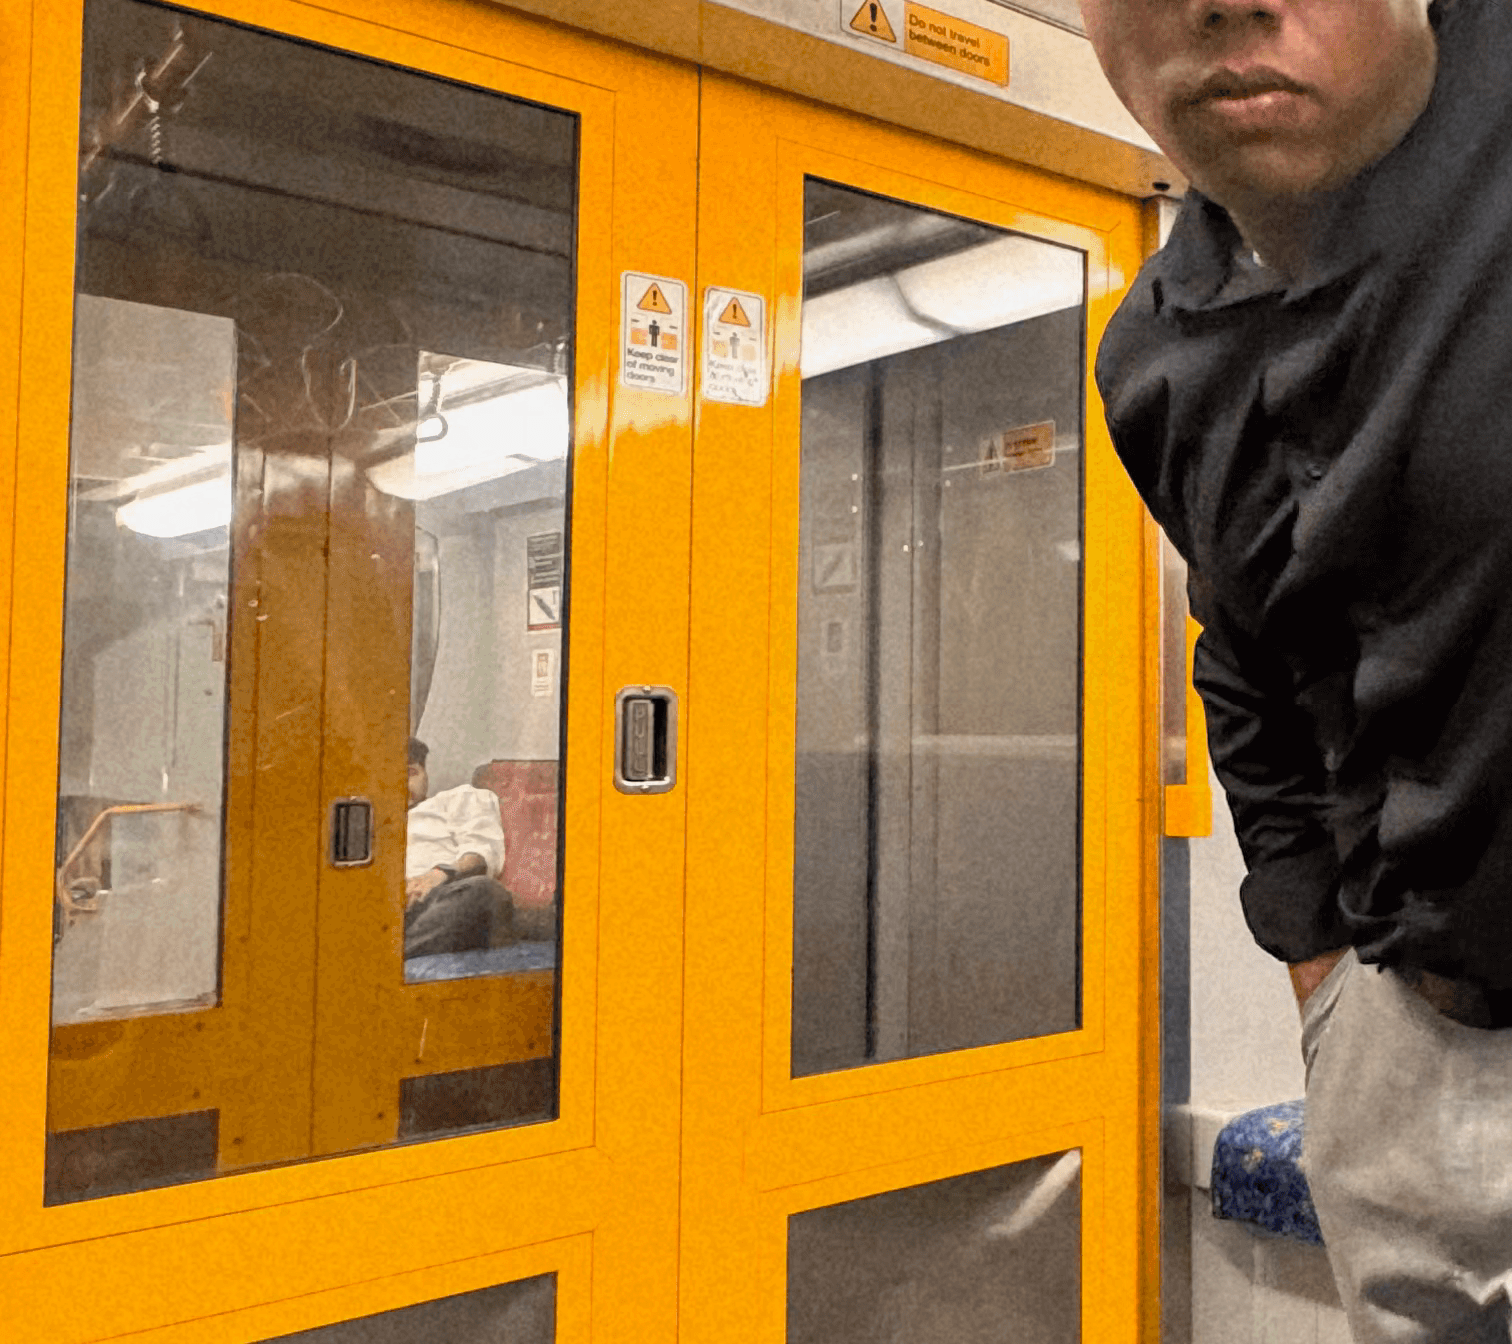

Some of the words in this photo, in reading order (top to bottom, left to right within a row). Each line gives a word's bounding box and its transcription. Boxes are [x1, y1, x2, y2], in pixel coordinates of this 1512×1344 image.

[909, 13, 926, 29] Do
[928, 23, 946, 37] not
[949, 28, 980, 49] travel
[908, 29, 956, 55] between
[960, 48, 990, 67] doors
[627, 347, 653, 360] Keep
[655, 354, 679, 363] clear
[626, 360, 637, 369] of
[639, 362, 675, 377] moving
[626, 371, 655, 384] doors
